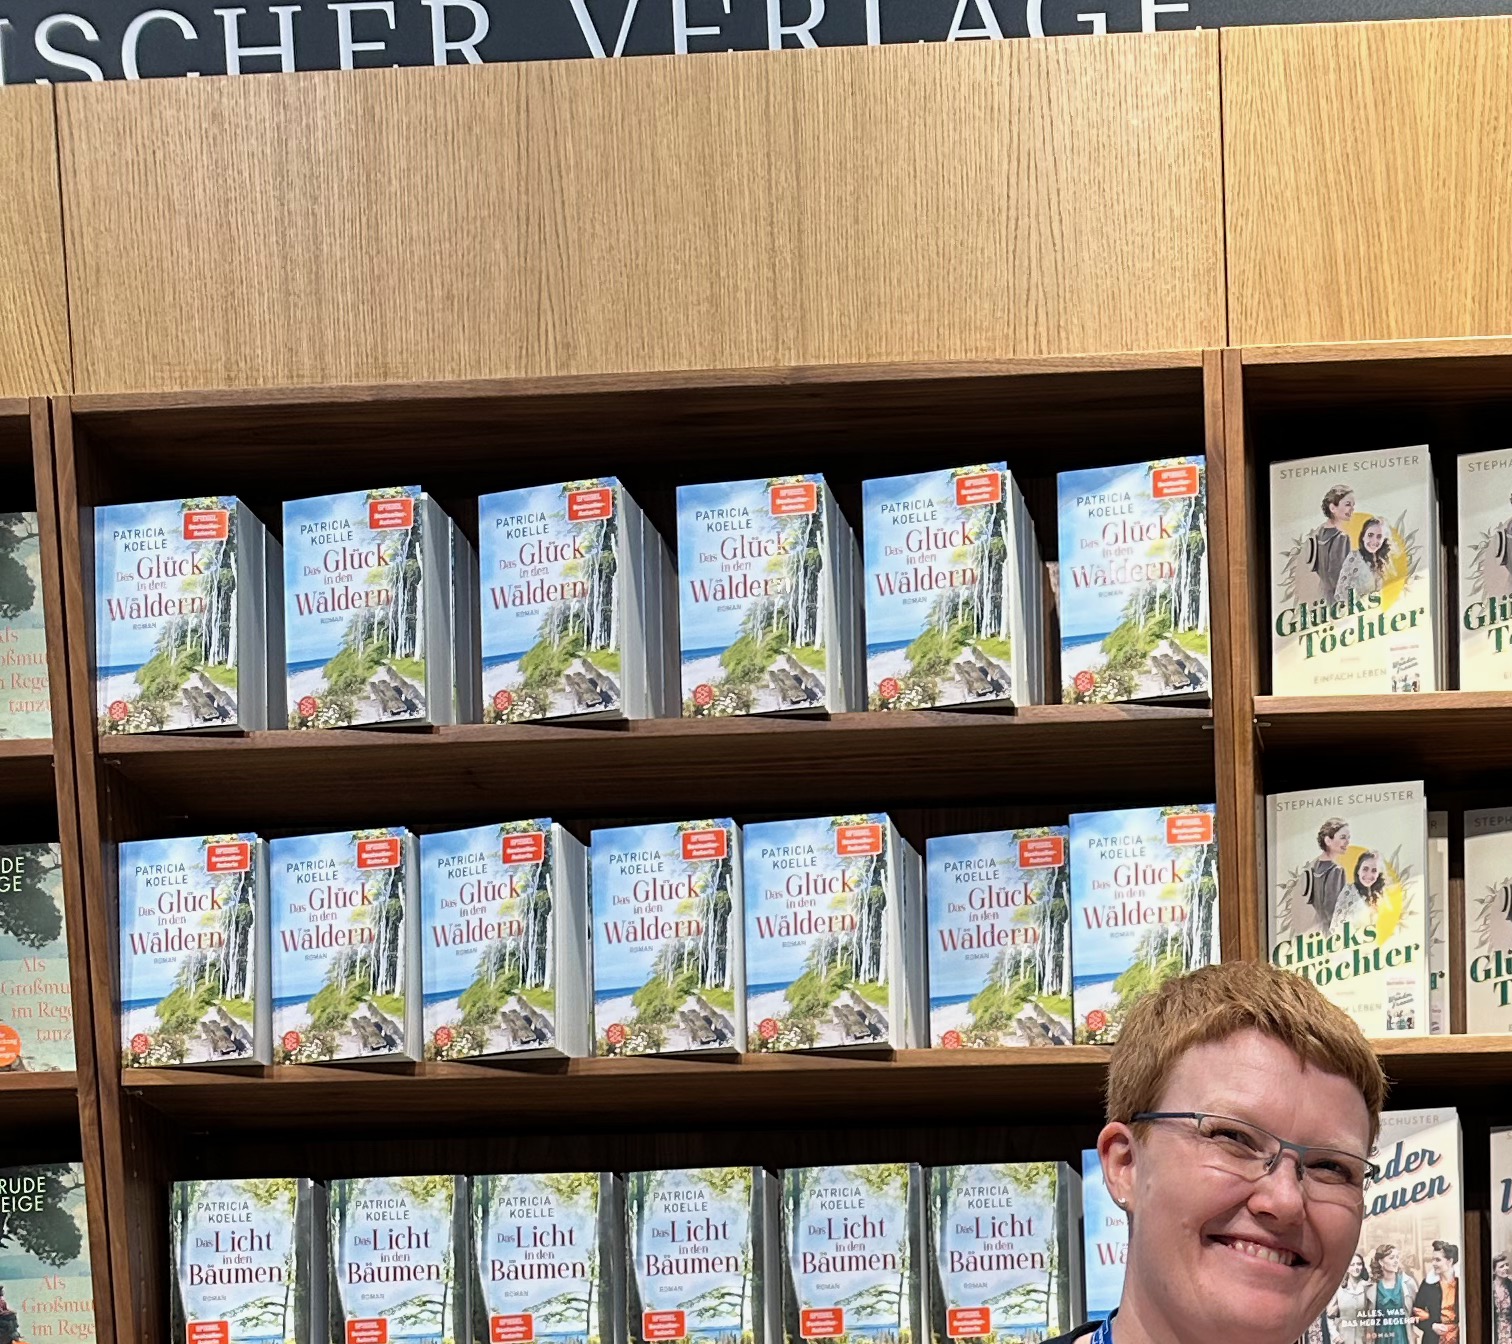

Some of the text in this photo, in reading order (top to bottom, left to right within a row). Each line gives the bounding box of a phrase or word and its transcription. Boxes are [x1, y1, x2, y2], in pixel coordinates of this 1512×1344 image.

[300, 519, 351, 535] PATRICIA
[310, 530, 353, 544] KOELLE
[303, 544, 391, 577] Das Glück
[323, 572, 353, 584] in den
[293, 585, 393, 617] Wäldern
[762, 844, 815, 859] PATRICIA
[772, 856, 817, 869] KOELLE
[765, 868, 854, 901] Das Glück
[786, 897, 816, 908] in den
[756, 910, 857, 940] Wäldern
[498, 1195, 552, 1209] PATRICIA
[510, 1207, 555, 1219] KOELLE
[497, 1224, 576, 1248] Das Licht
[525, 1248, 555, 1260] in den
[490, 1259, 586, 1282] Bäumen
